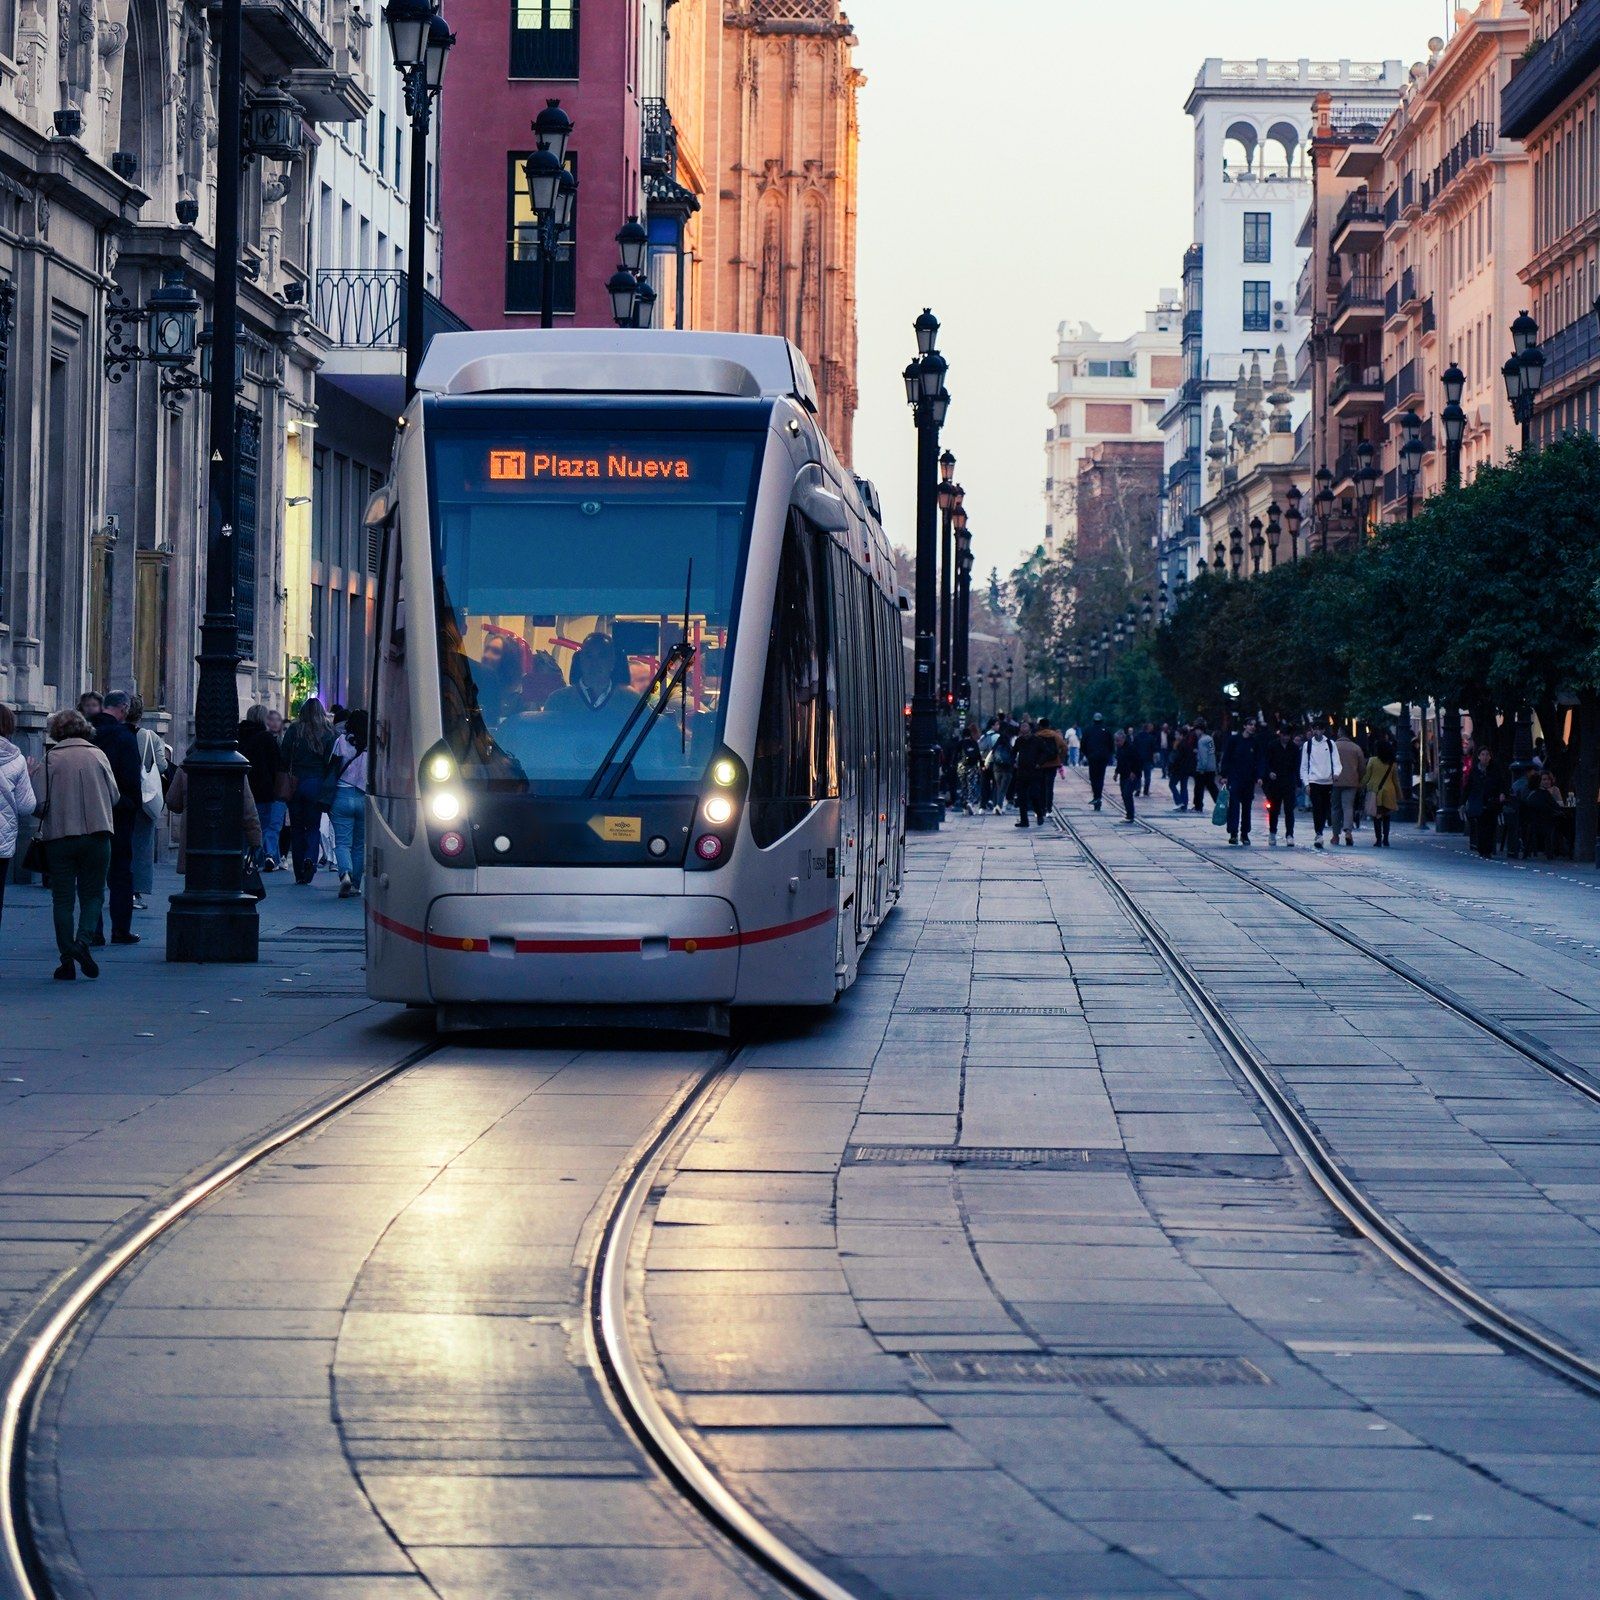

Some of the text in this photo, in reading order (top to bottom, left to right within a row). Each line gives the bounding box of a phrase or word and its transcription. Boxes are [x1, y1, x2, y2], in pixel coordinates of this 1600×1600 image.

[1229, 181, 1277, 199] AXA
[493, 453, 689, 478] T1 Plaza Nueva
